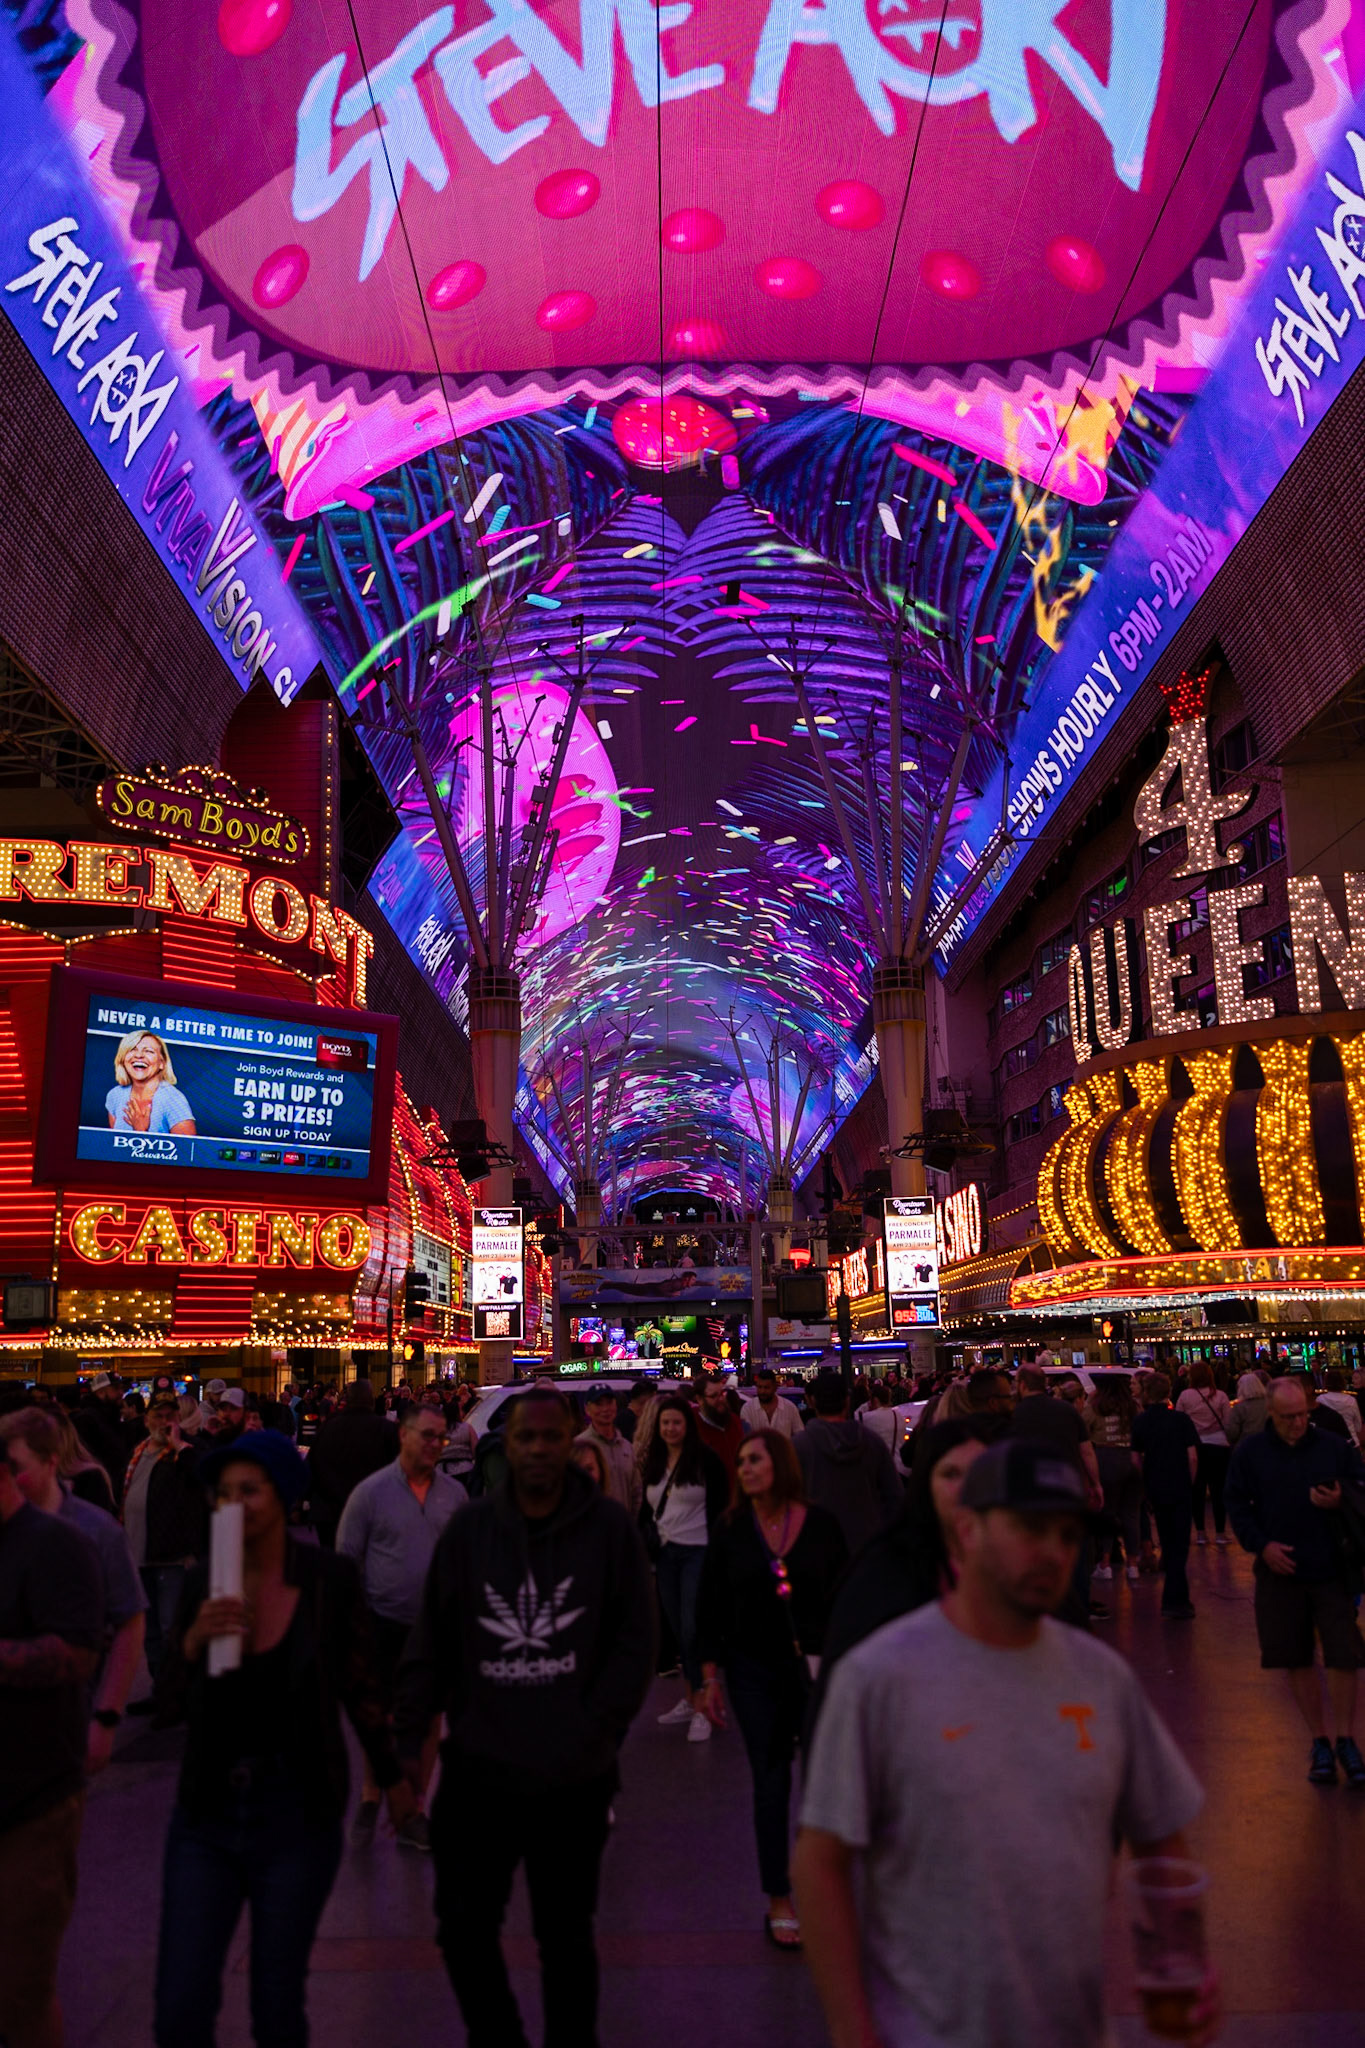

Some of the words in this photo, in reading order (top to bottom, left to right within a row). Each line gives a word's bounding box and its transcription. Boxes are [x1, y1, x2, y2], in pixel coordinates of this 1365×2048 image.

[292, 0, 725, 282] STEVE
[5, 217, 122, 371] STEVE
[142, 430, 213, 582] VIVA
[195, 496, 277, 681] VISION
[1007, 750, 1063, 836] SHOWS
[1047, 650, 1122, 770] HOURLY
[1255, 265, 1350, 428] STEVE
[1134, 715, 1253, 880] 4
[111, 781, 193, 829] Sam
[199, 802, 299, 853] Boyd's
[1068, 871, 1365, 1065] QUEEN
[98, 1008, 146, 1028] NEVER
[151, 1016, 161, 1029] A
[166, 1018, 216, 1037] BETTER
[220, 1025, 253, 1041] TIME
[257, 1030, 274, 1044] TO
[277, 1033, 313, 1049] JOIN!
[322, 1042, 351, 1052] BOYD
[236, 1063, 257, 1074] Join
[259, 1065, 284, 1080] Boyd
[286, 1068, 324, 1081] Rewards
[327, 1072, 344, 1083] and
[234, 1077, 285, 1100] EARN
[290, 1084, 318, 1103] UP
[321, 1088, 344, 1107] TO
[242, 1101, 256, 1119] 3
[260, 1104, 333, 1127] PRIZES!
[113, 1135, 176, 1152] BOYD
[243, 1125, 272, 1137] SIGN
[275, 1128, 290, 1139] UP
[293, 1130, 331, 1143] TODAY
[131, 1146, 178, 1162] Rewards
[69, 1202, 371, 1271] CASINO
[889, 1230, 931, 1239] PARMALEE
[936, 1182, 982, 1269] ASINO
[476, 1240, 518, 1250] PARMALEE
[559, 1361, 588, 1374] CIGARS
[1060, 1706, 1094, 1750] T
